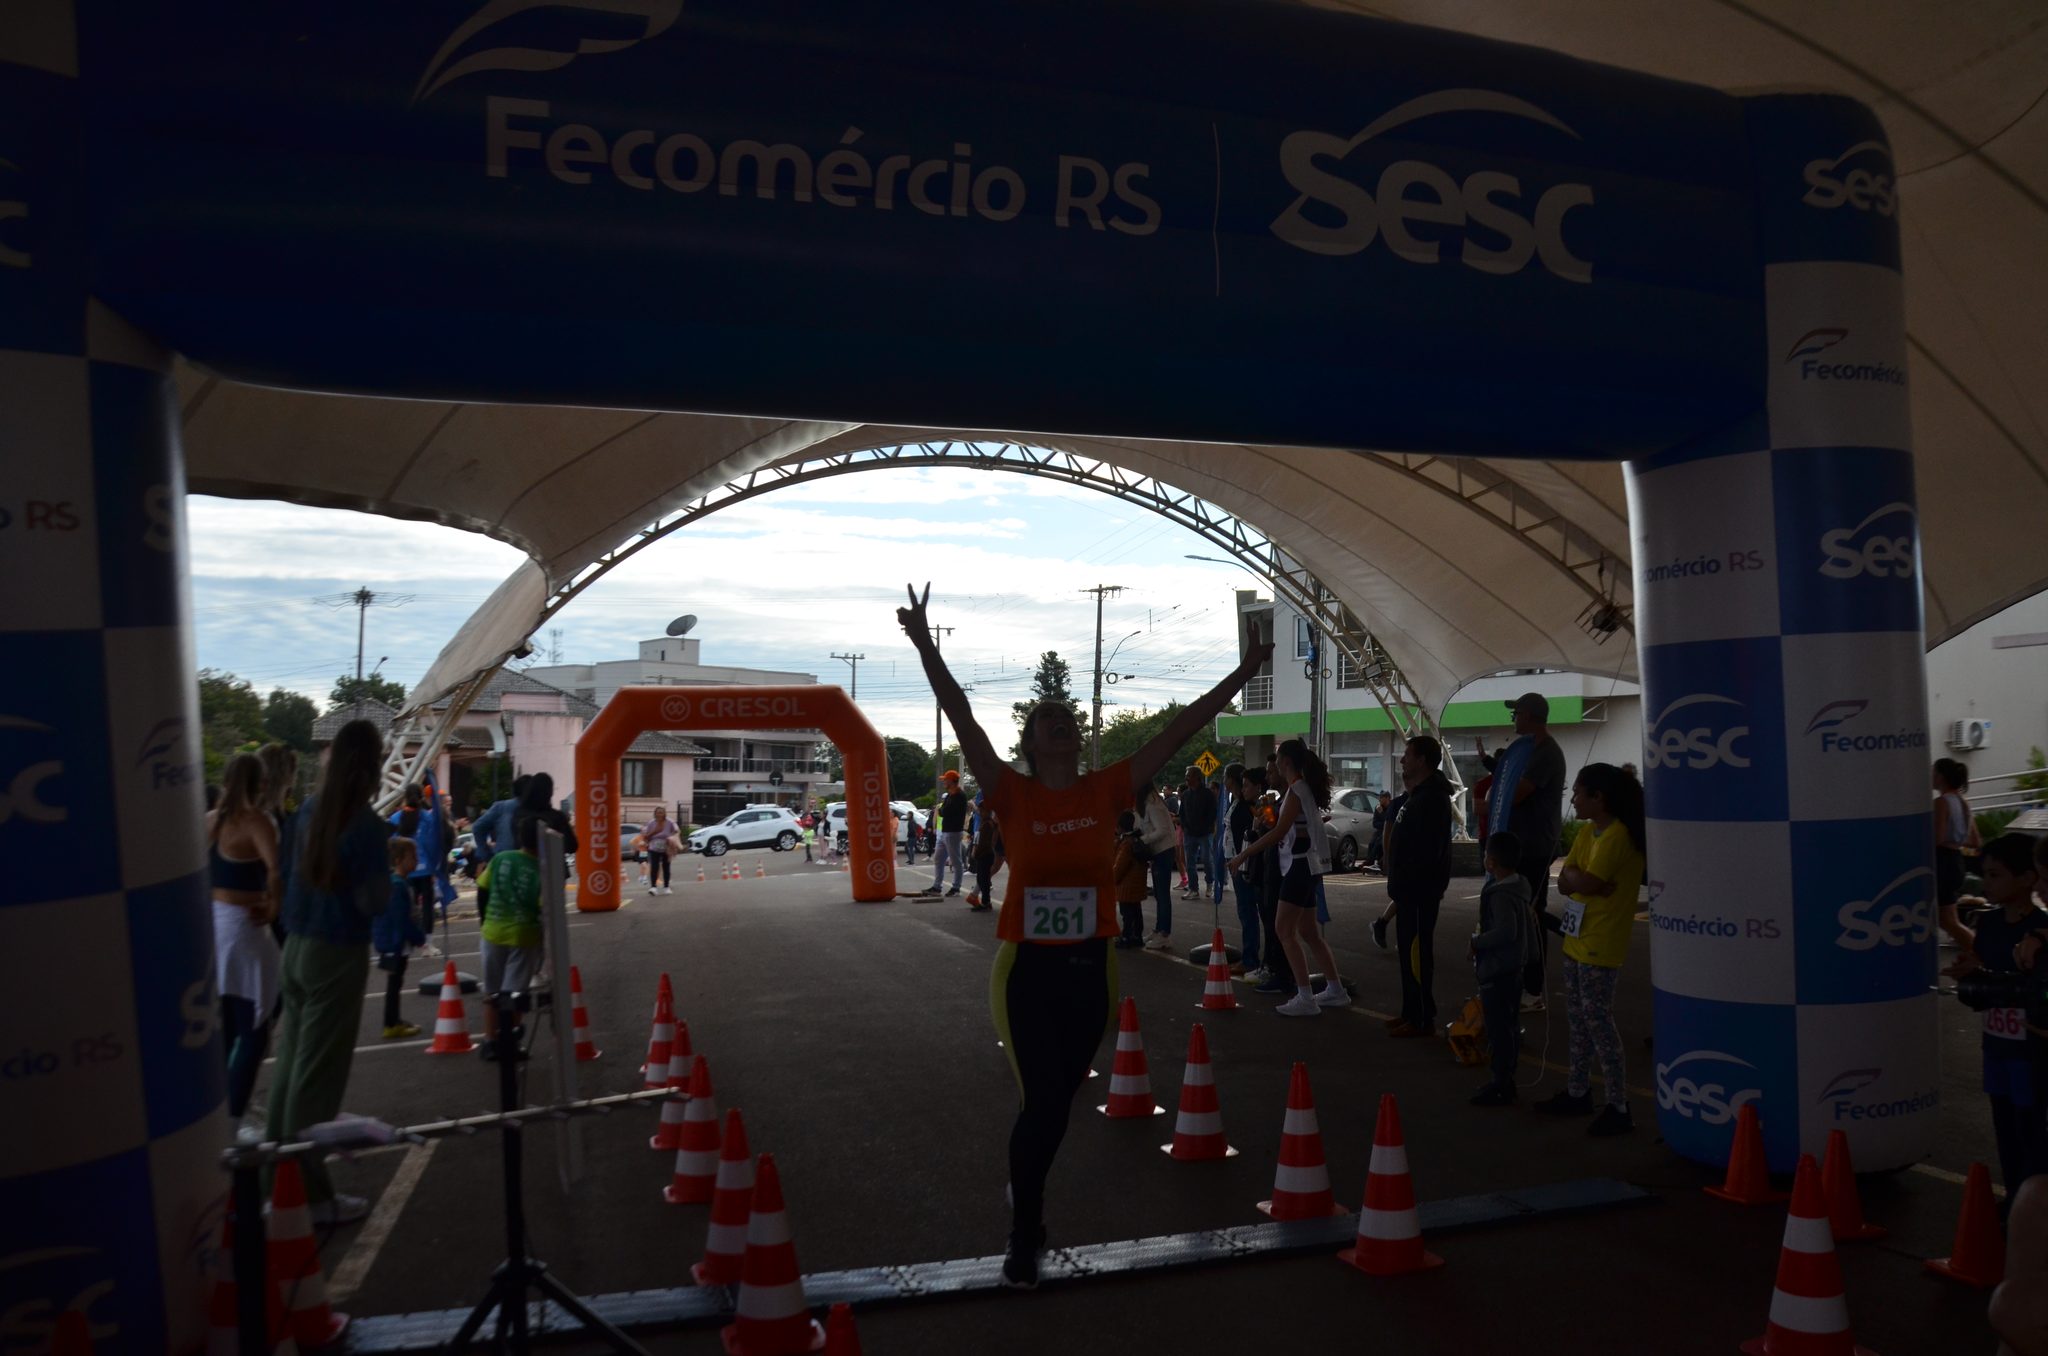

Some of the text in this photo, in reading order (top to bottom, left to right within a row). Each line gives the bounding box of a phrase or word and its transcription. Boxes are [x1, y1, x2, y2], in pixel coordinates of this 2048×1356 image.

[485, 95, 1163, 237] Fecomércio RS
[1268, 129, 1596, 284] Sesc
[26, 500, 80, 532] RS
[1728, 550, 1764, 572] RS
[699, 695, 806, 719] CRESOL
[589, 773, 608, 864] CRESOL
[863, 764, 885, 853] CRESOL
[1048, 816, 1100, 835] CRESOL
[1033, 906, 1085, 935] 261
[1745, 918, 1781, 939] RS
[70, 1033, 124, 1068] RS
